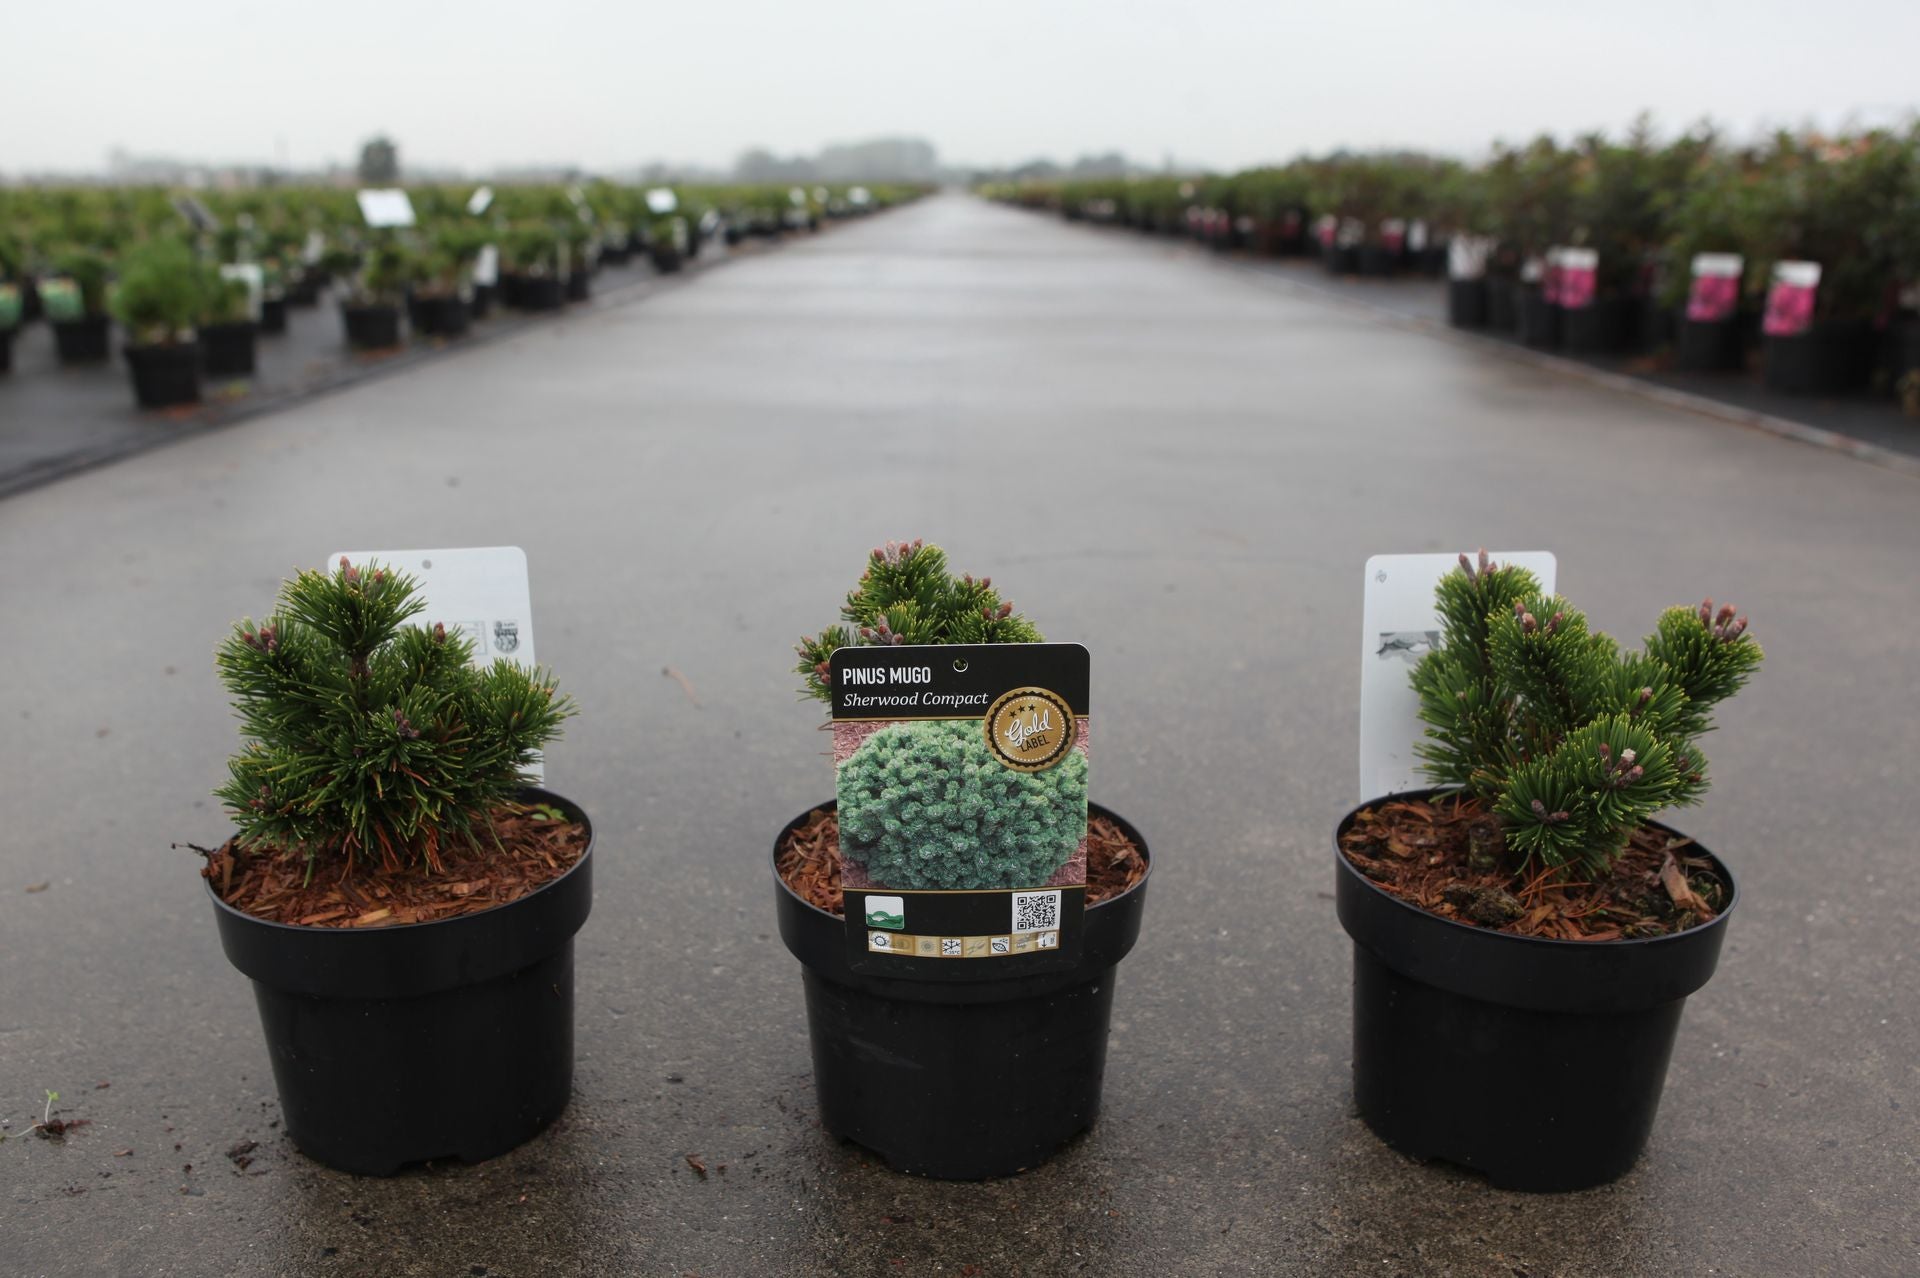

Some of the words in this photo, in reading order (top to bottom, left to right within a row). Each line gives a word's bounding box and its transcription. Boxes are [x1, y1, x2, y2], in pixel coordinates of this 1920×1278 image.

[842, 667, 886, 685] PINUS
[889, 666, 931, 684] MUGO
[843, 692, 918, 707] Sherwood
[922, 691, 989, 708] Compact
[1004, 709, 1053, 746] Gold
[1020, 736, 1050, 753] LABEL
